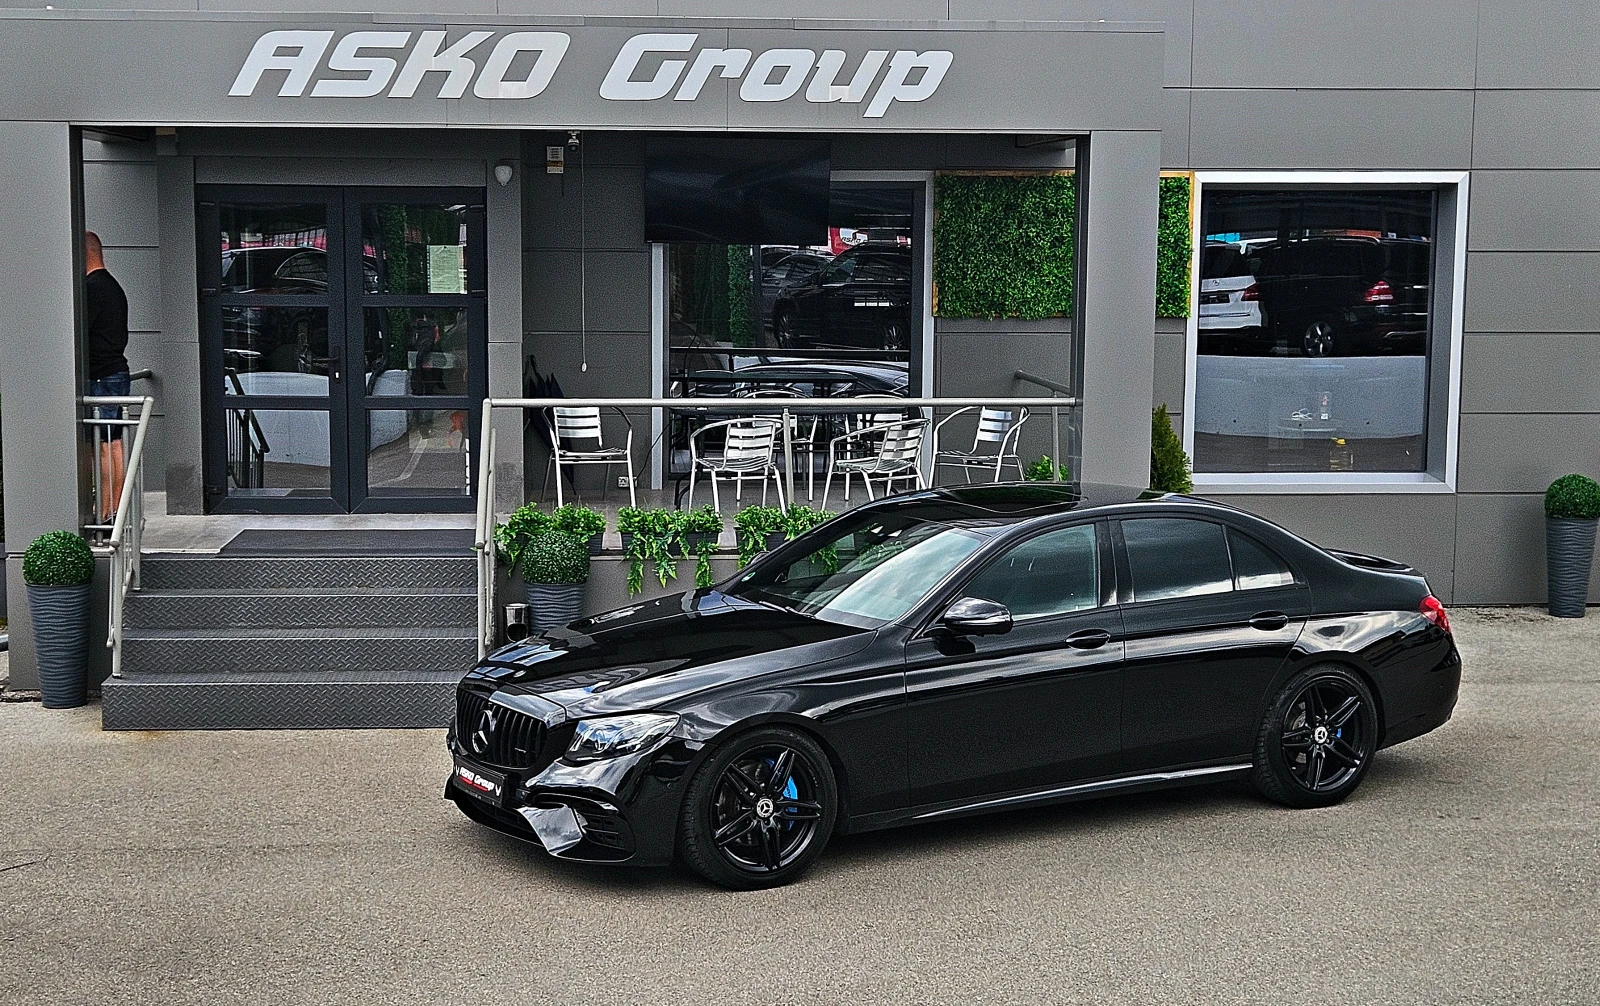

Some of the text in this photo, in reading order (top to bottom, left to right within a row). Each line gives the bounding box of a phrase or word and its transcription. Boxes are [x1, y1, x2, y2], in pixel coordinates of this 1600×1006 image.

[228, 30, 954, 118] ASKO Group
[460, 766, 495, 791] ASKO Group
